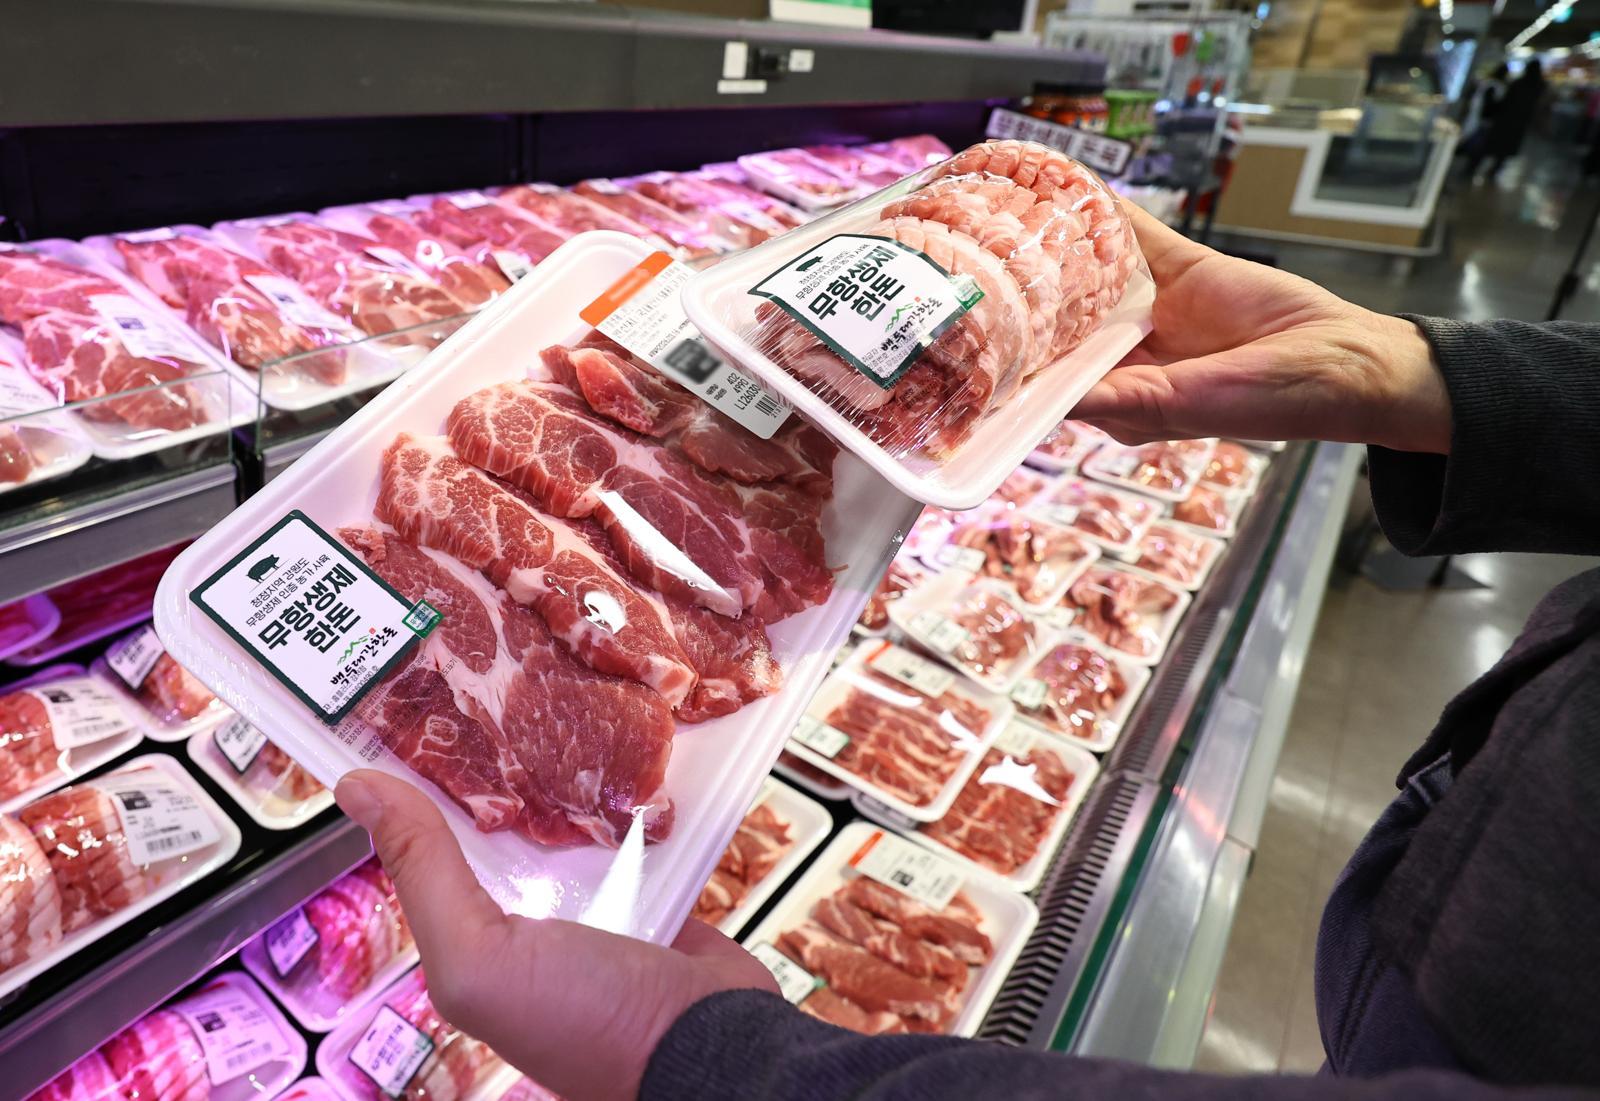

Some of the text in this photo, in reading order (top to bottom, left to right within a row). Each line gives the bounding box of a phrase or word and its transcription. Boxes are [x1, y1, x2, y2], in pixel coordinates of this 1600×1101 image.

[807, 245, 898, 318] 무항생제
[850, 273, 905, 321] 한돈
[725, 371, 740, 385] 402
[245, 552, 330, 628] 무항생제 인증 농가 사육
[249, 555, 310, 609] 청정지역 강원도
[258, 563, 358, 649] 무항생제
[303, 602, 361, 653] 한돈
[330, 626, 398, 686] 백두대간한돈
